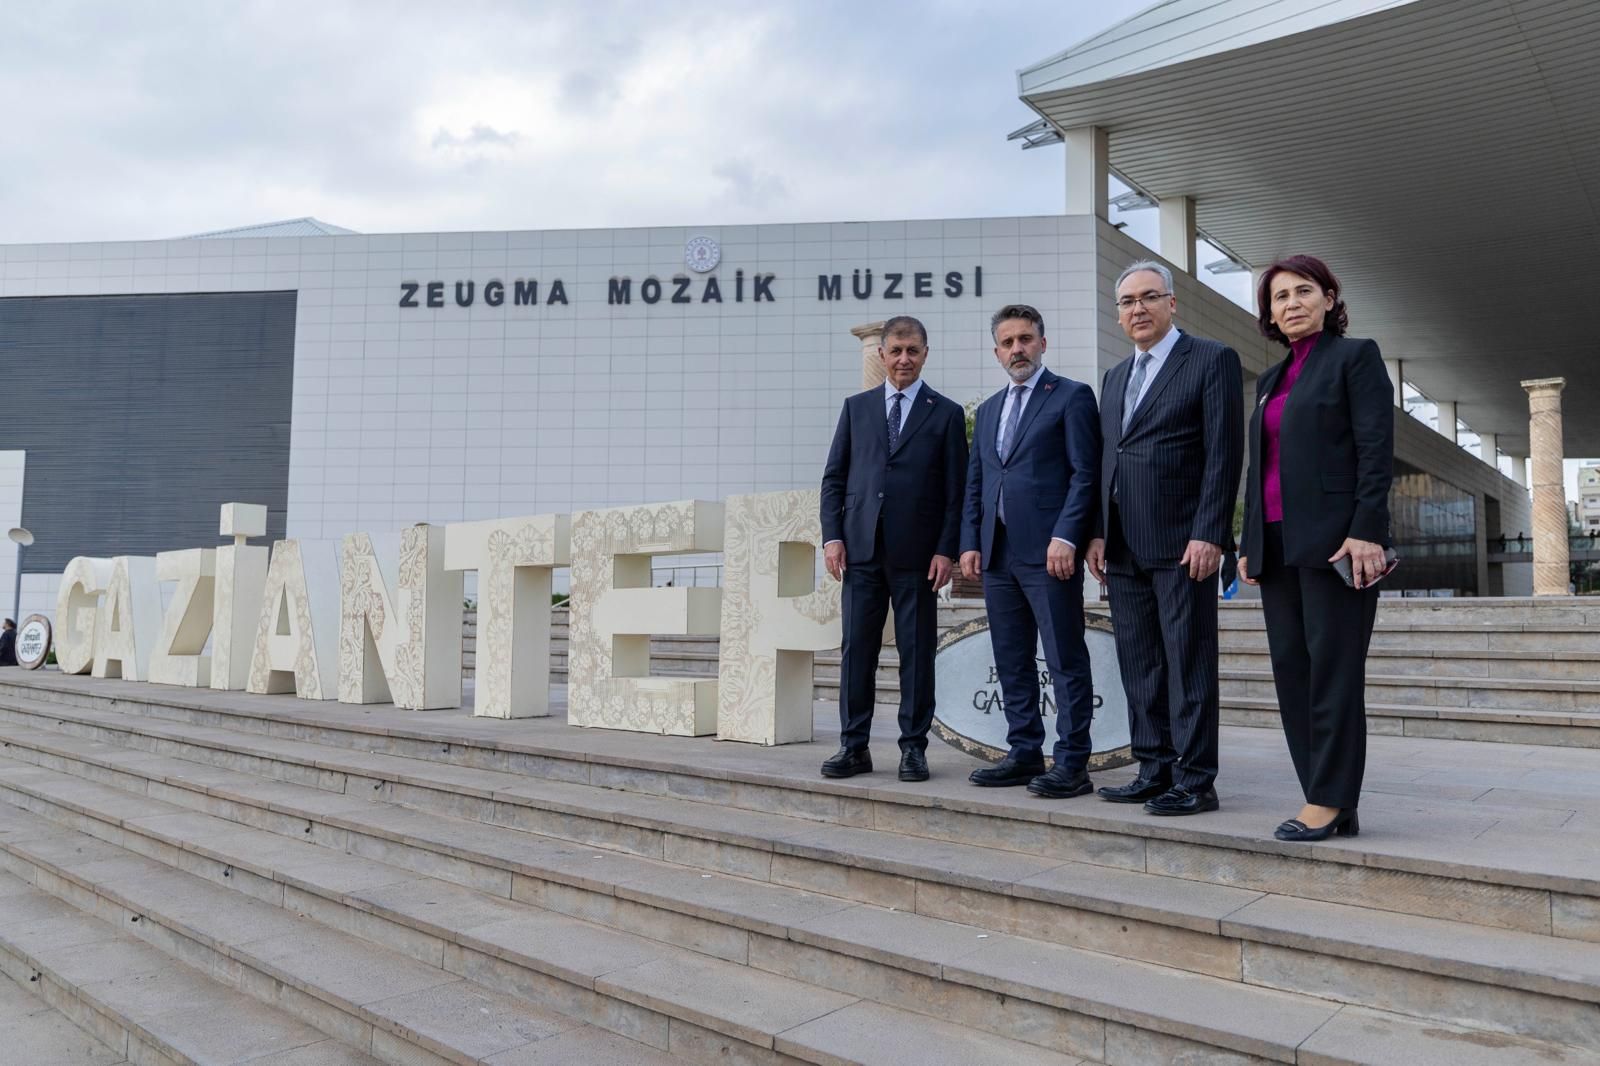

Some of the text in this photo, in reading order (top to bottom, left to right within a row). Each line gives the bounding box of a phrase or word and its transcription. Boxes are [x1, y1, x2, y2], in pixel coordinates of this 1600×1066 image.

[399, 265, 983, 308] ZEUGMA MOZAİK MÜZESİ
[55, 489, 845, 746] GAZİANTEP
